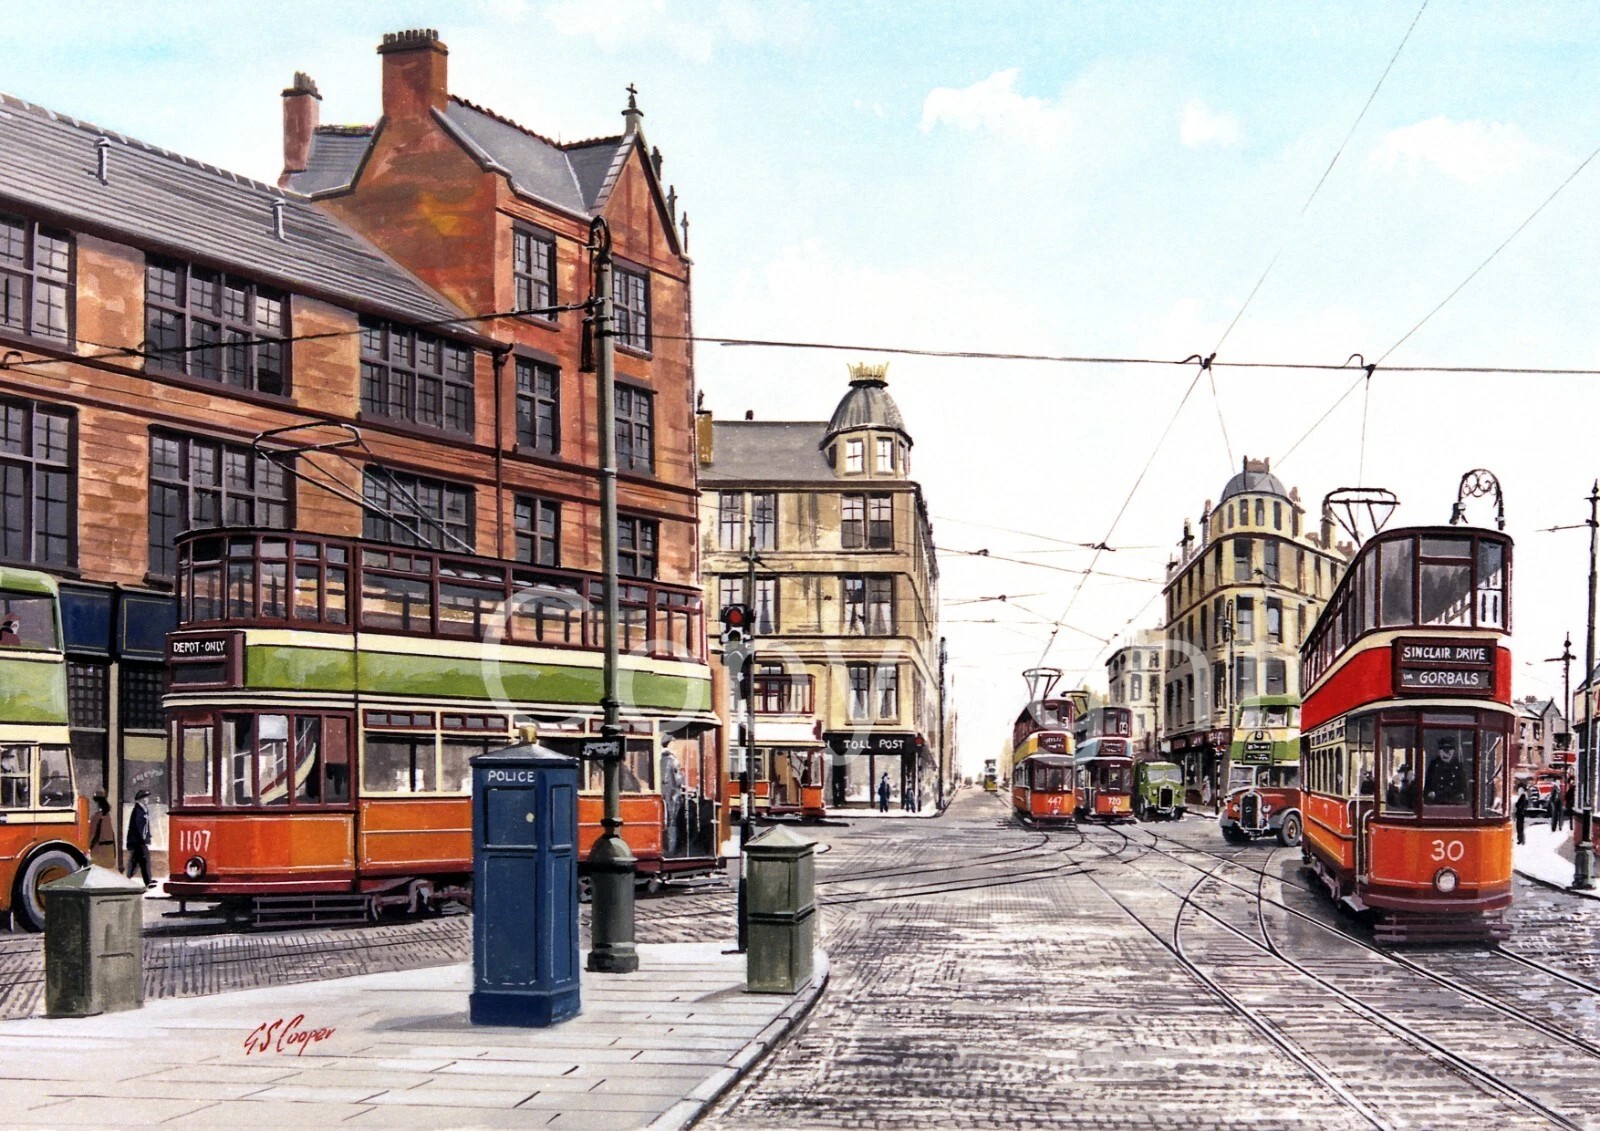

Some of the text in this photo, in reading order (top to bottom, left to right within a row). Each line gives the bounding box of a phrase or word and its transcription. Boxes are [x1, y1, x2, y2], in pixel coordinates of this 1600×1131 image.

[1403, 646, 1486, 660] SINCLAIR DRIVE
[1419, 671, 1479, 685] GORBALS
[844, 739, 904, 749] TOLL POST
[488, 770, 536, 782] POLICE
[1047, 796, 1062, 806] 447
[180, 830, 211, 852] 1107
[1431, 839, 1464, 861] 30
[277, 1014, 336, 1056] Cooper
